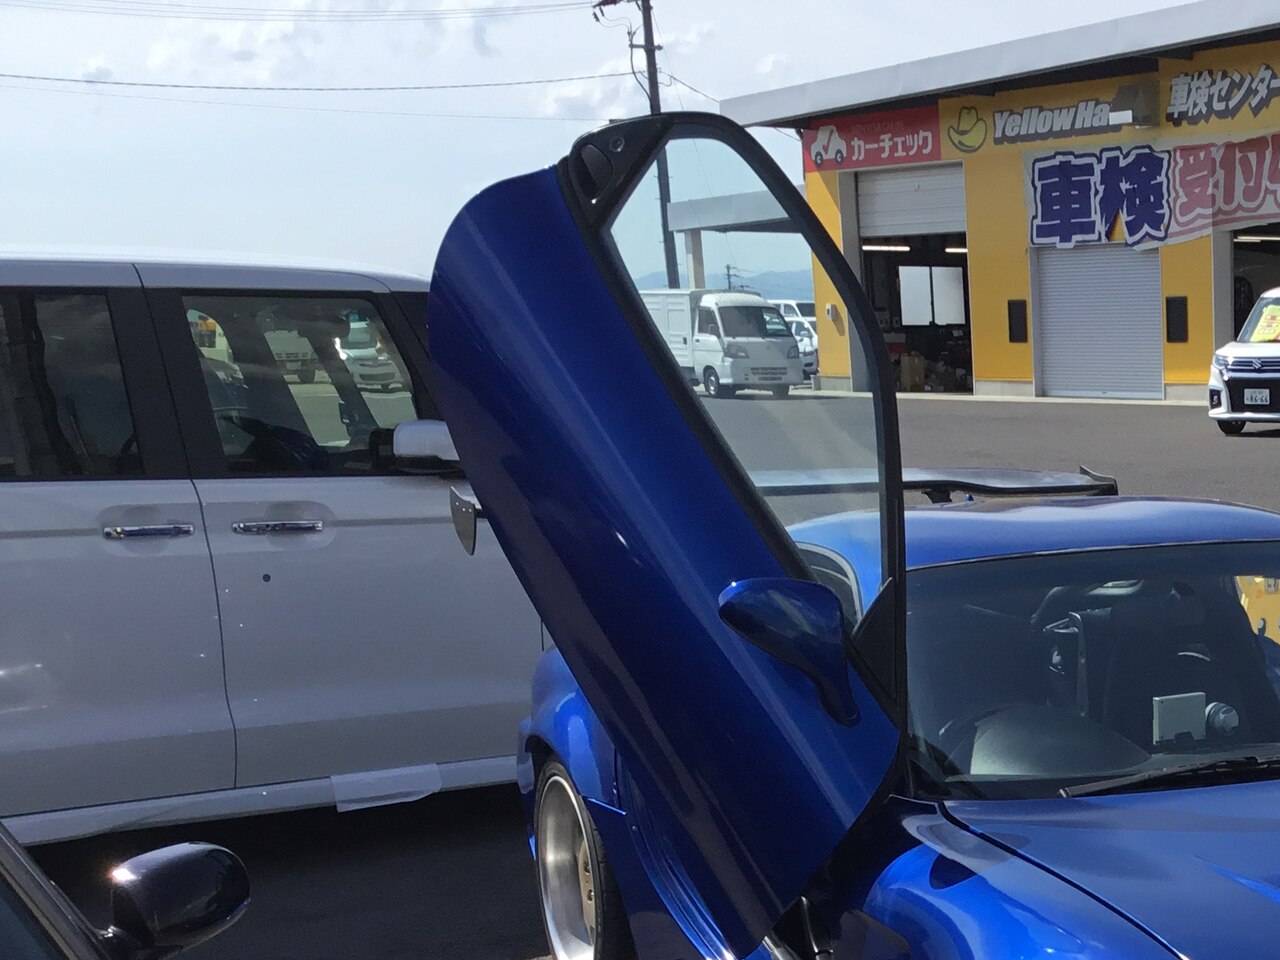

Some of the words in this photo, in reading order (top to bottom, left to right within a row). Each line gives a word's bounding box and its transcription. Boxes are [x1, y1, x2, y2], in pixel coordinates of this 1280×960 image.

[993, 100, 1113, 139] YellowHa
[850, 129, 933, 162] カーチェック
